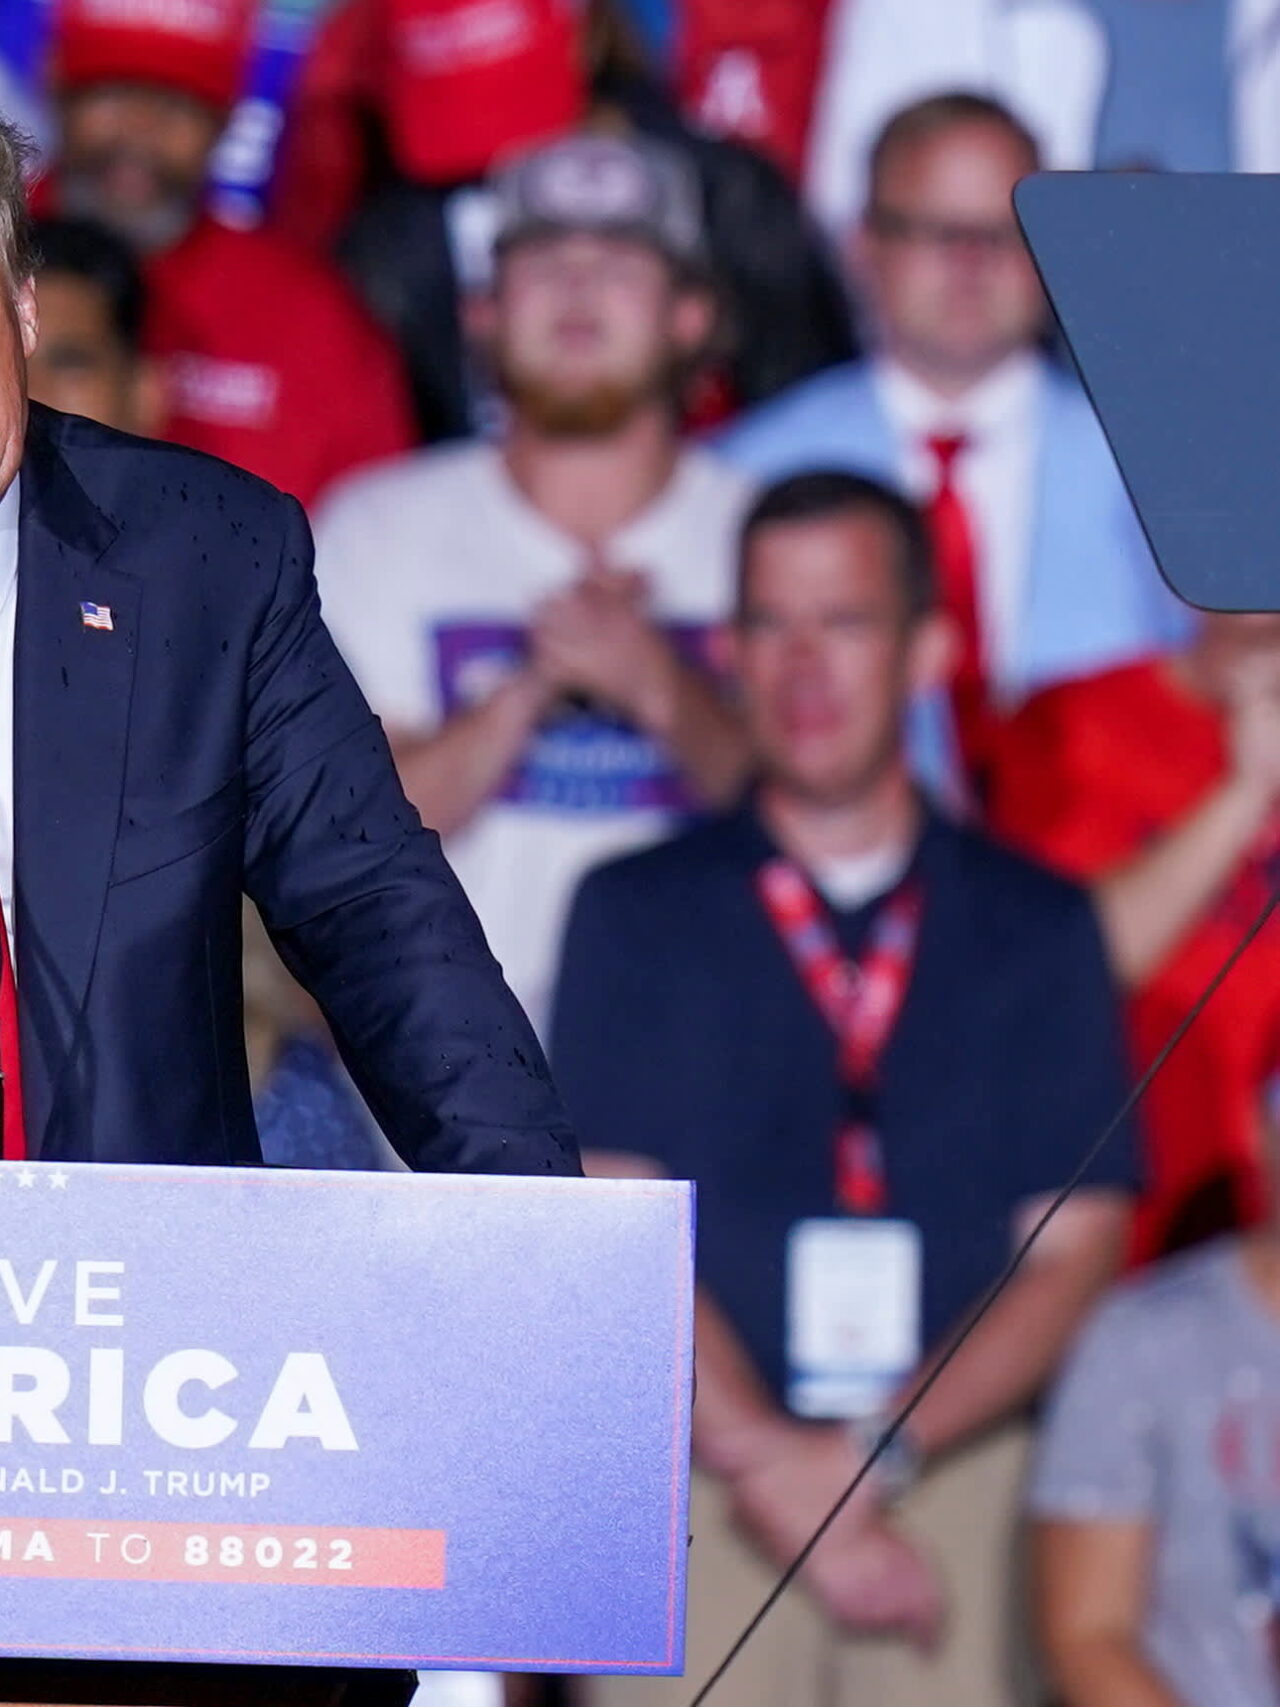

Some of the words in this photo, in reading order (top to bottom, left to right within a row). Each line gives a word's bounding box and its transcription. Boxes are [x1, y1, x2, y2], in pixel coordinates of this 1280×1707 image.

[99, 1470, 126, 1496] J.
[143, 1470, 271, 1498] TRUMP
[86, 1532, 152, 1565] TO
[184, 1535, 354, 1570] 88022
